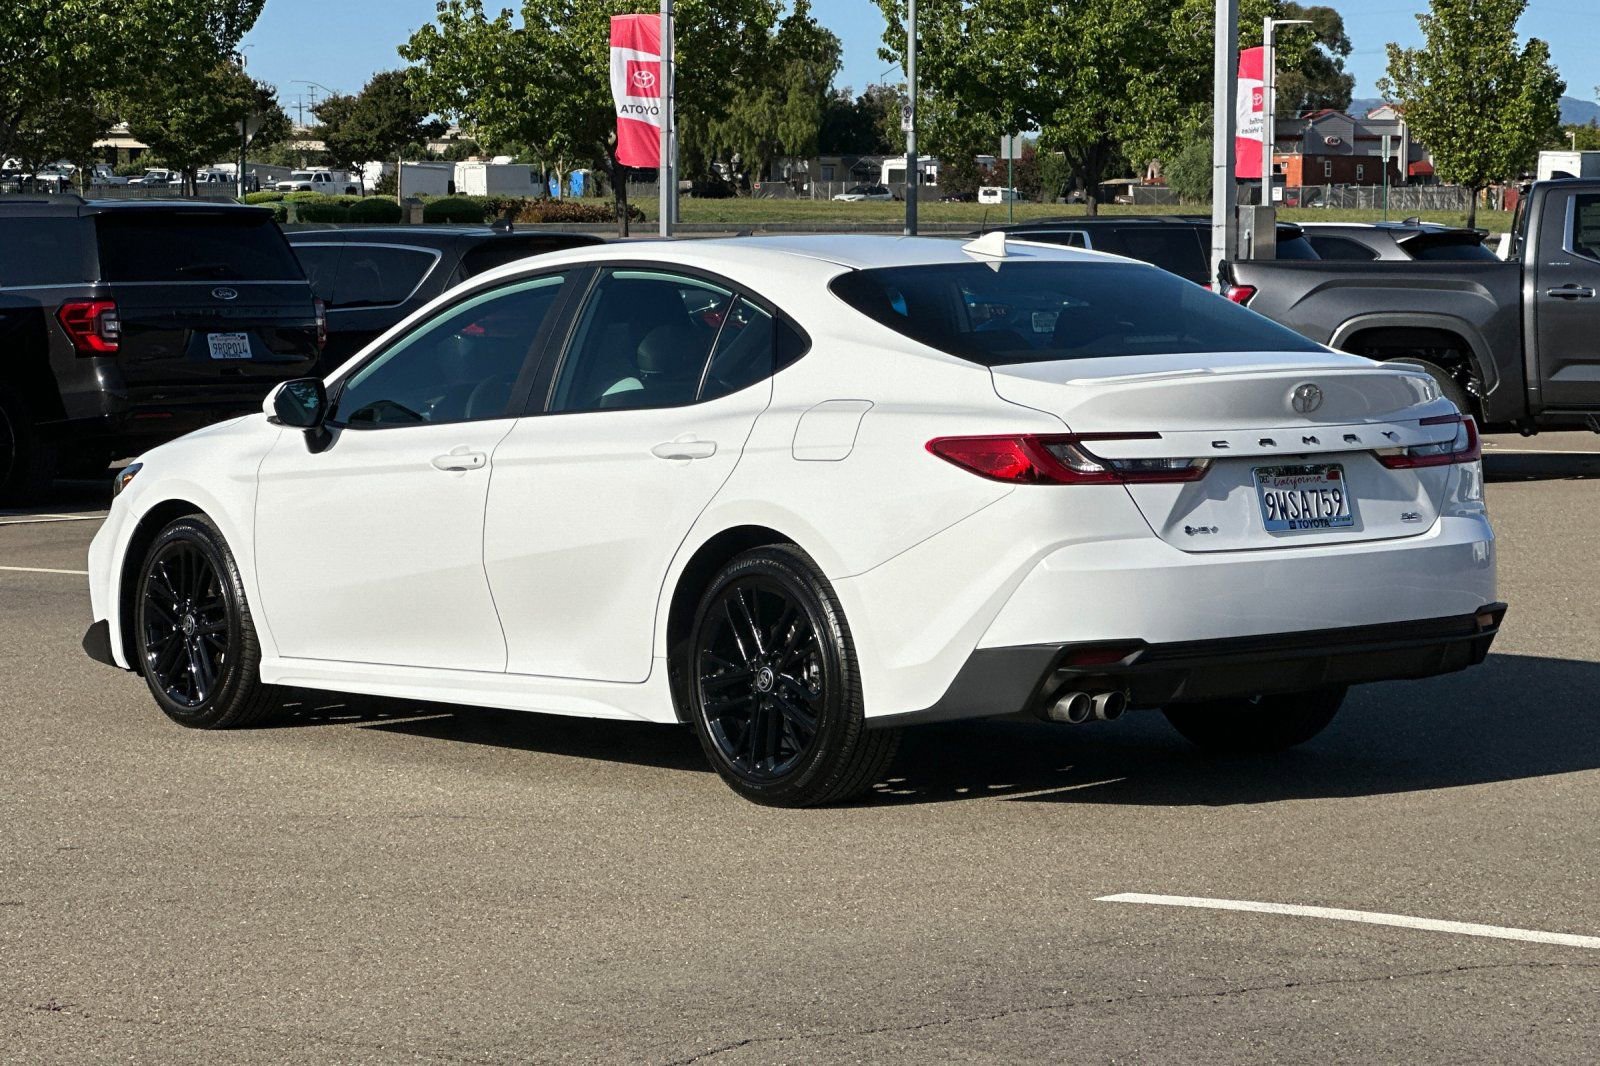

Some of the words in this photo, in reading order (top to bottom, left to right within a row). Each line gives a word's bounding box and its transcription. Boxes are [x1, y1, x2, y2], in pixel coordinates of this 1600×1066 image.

[1211, 430, 1395, 449] CAMRY
[1273, 475, 1328, 489] California
[1264, 488, 1344, 521] 9WSA759
[1298, 518, 1331, 530] TOYOTA
